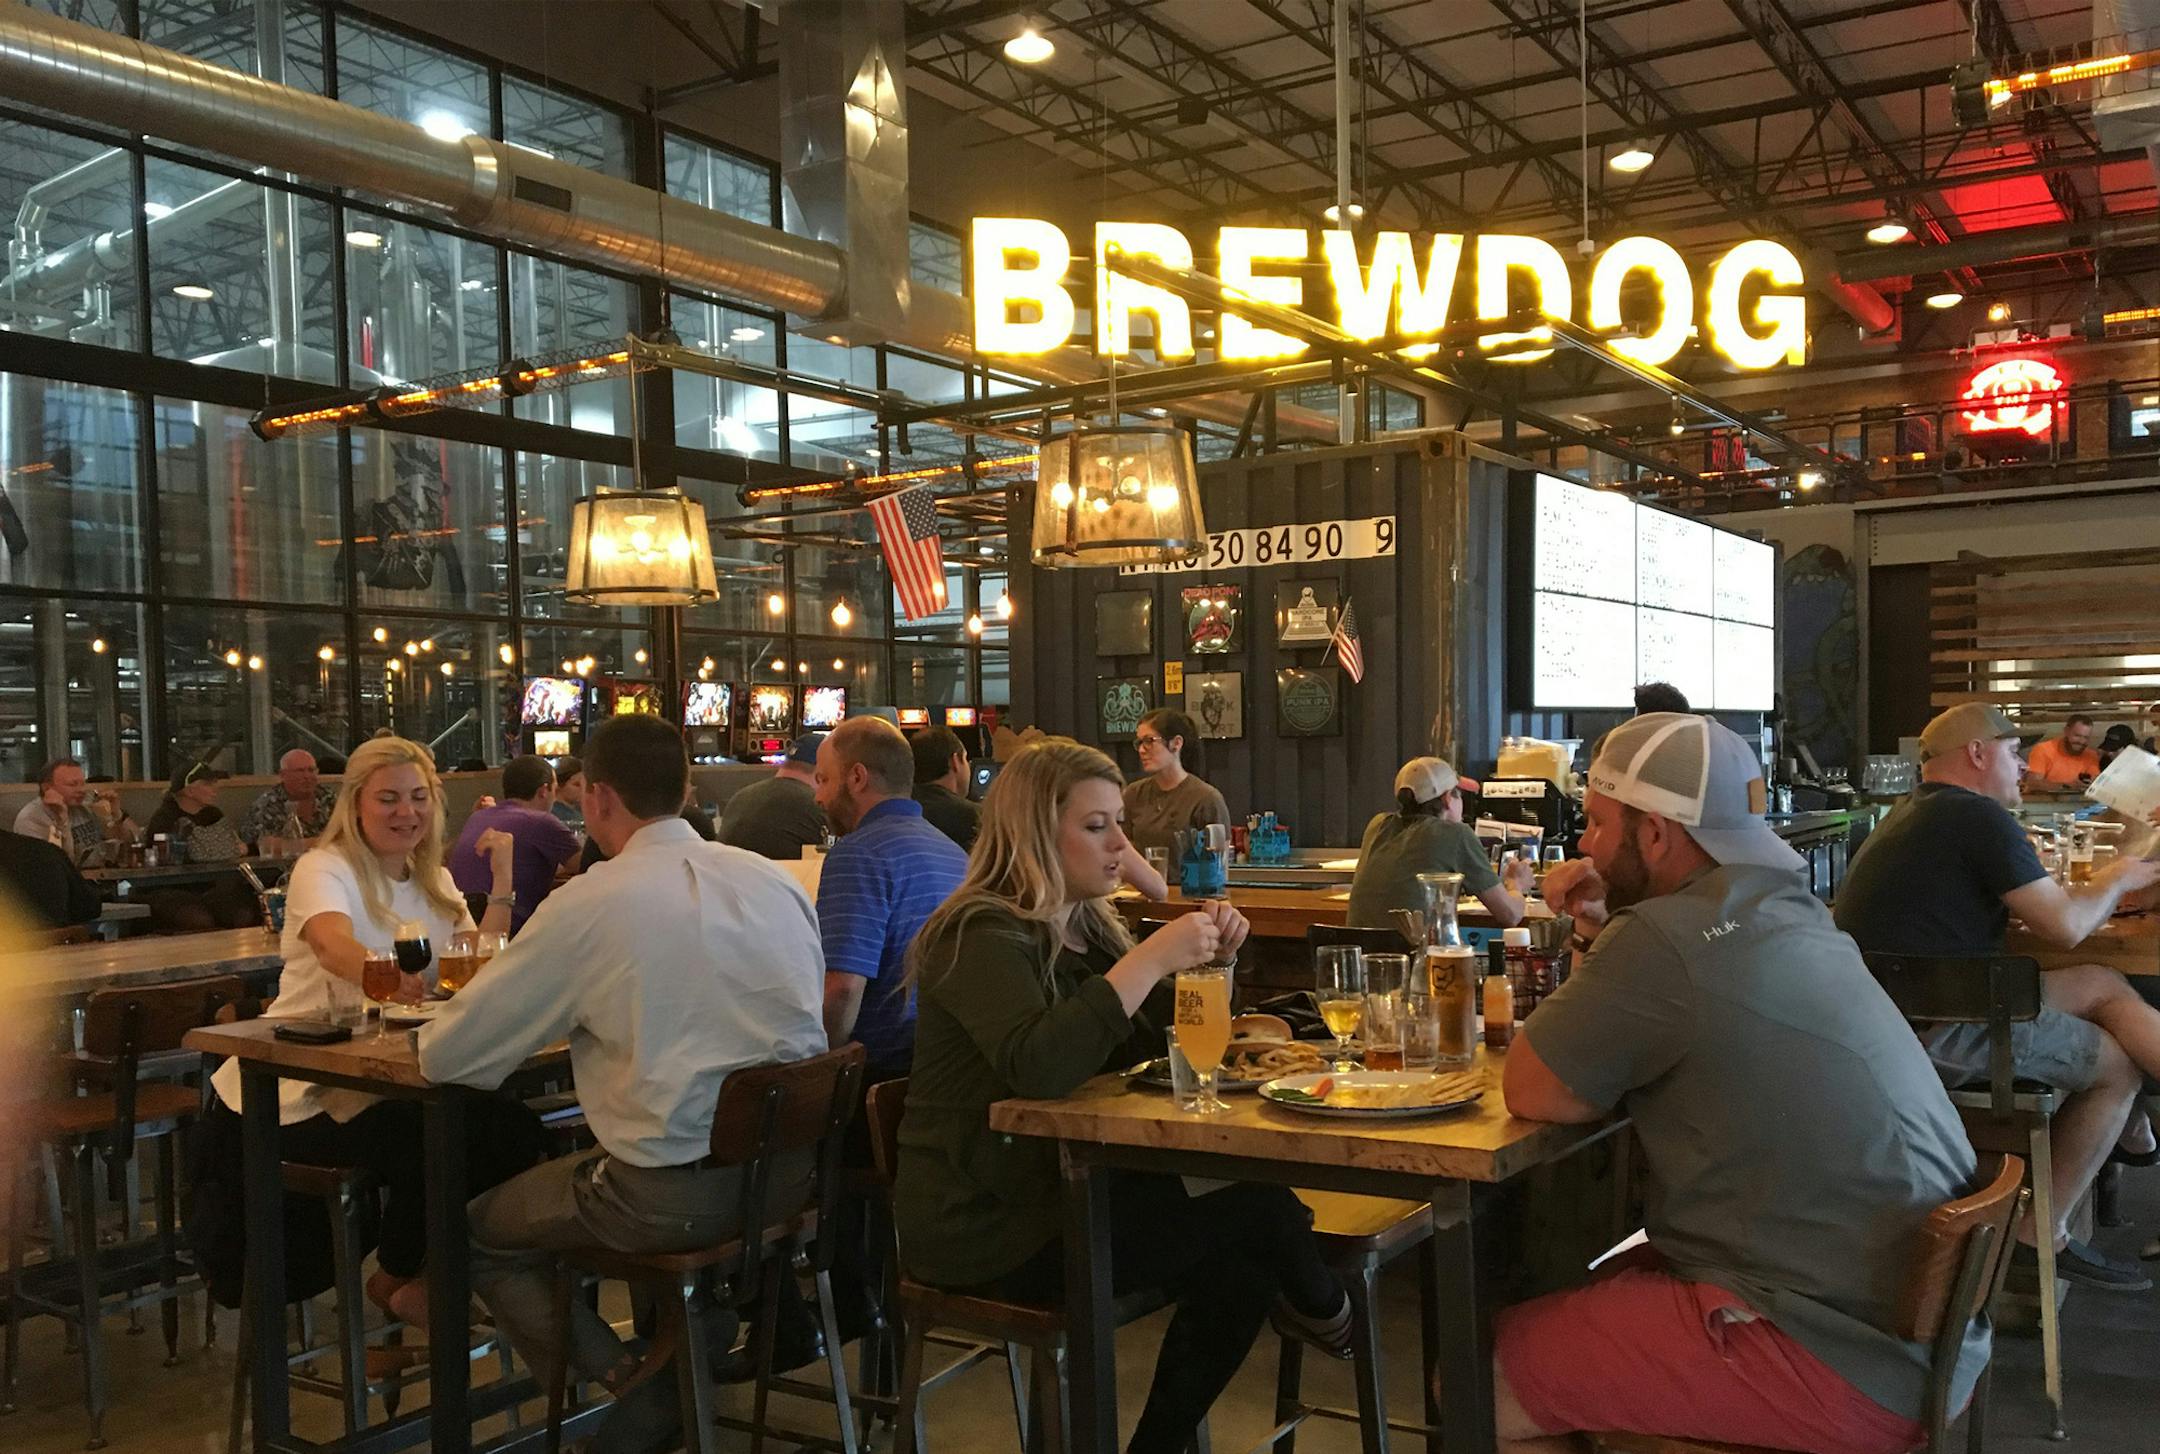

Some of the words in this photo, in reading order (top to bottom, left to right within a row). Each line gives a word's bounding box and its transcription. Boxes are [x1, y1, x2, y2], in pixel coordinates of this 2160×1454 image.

[973, 217, 1806, 369] BREWDOG
[1209, 532, 1244, 567] 30
[1256, 527, 1293, 563] 84
[1305, 523, 1342, 559] 90
[1375, 518, 1394, 553] 9
[1106, 720, 1137, 733] BREWD
[1178, 990, 1202, 998] REAL
[1178, 998, 1203, 1008] BEER
